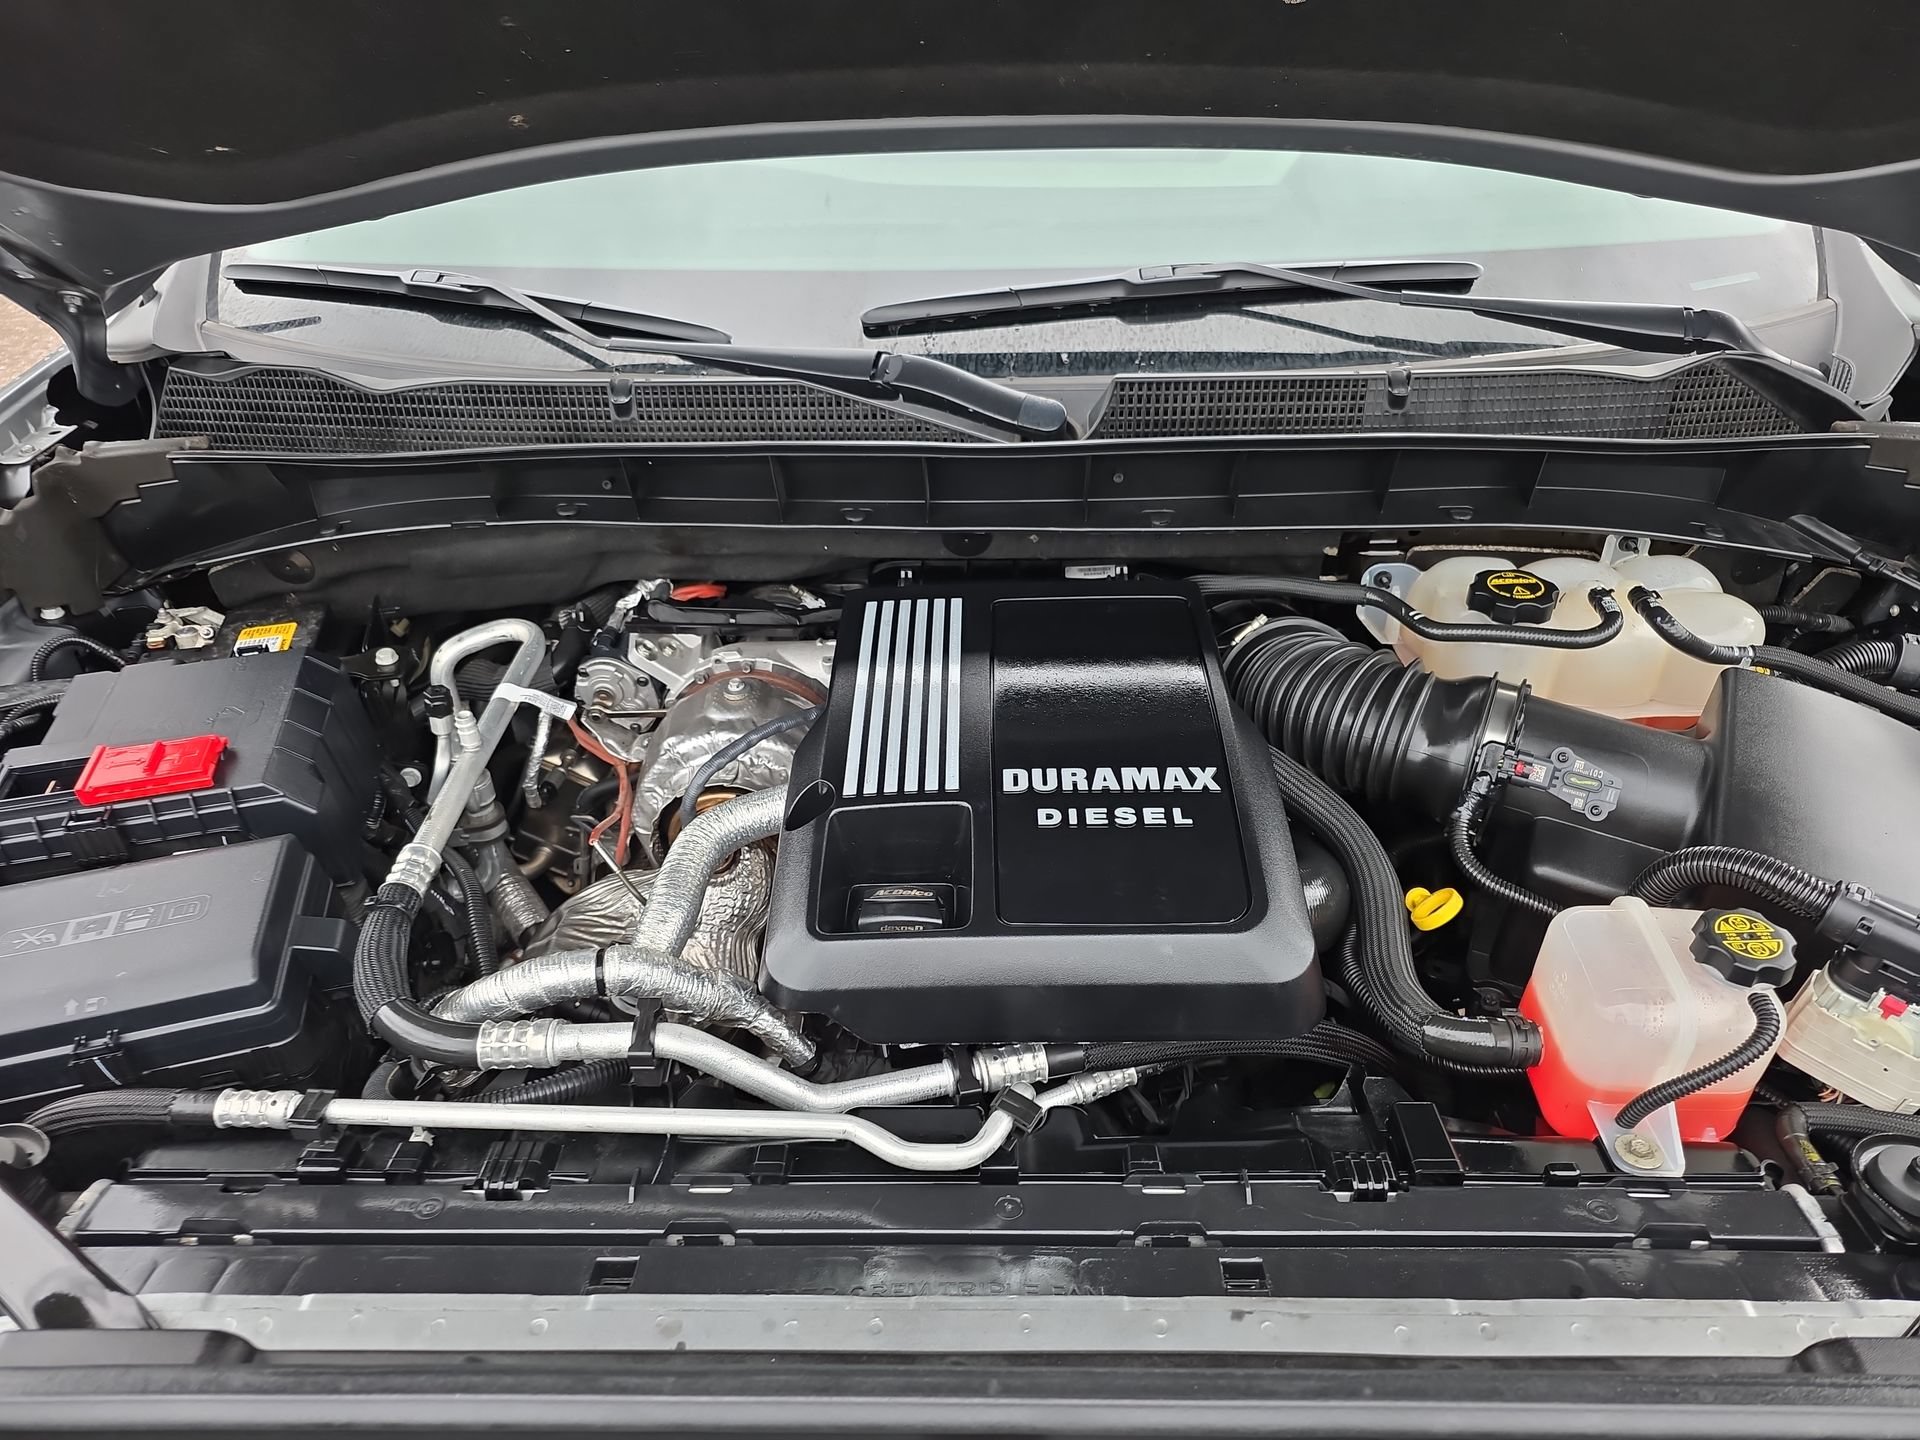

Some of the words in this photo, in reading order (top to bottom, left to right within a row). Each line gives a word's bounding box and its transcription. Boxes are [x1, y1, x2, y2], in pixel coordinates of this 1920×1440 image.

[1002, 766, 1222, 793] DURAMAX
[1037, 806, 1194, 828] DIESEL
[872, 888, 934, 898] ACDelco
